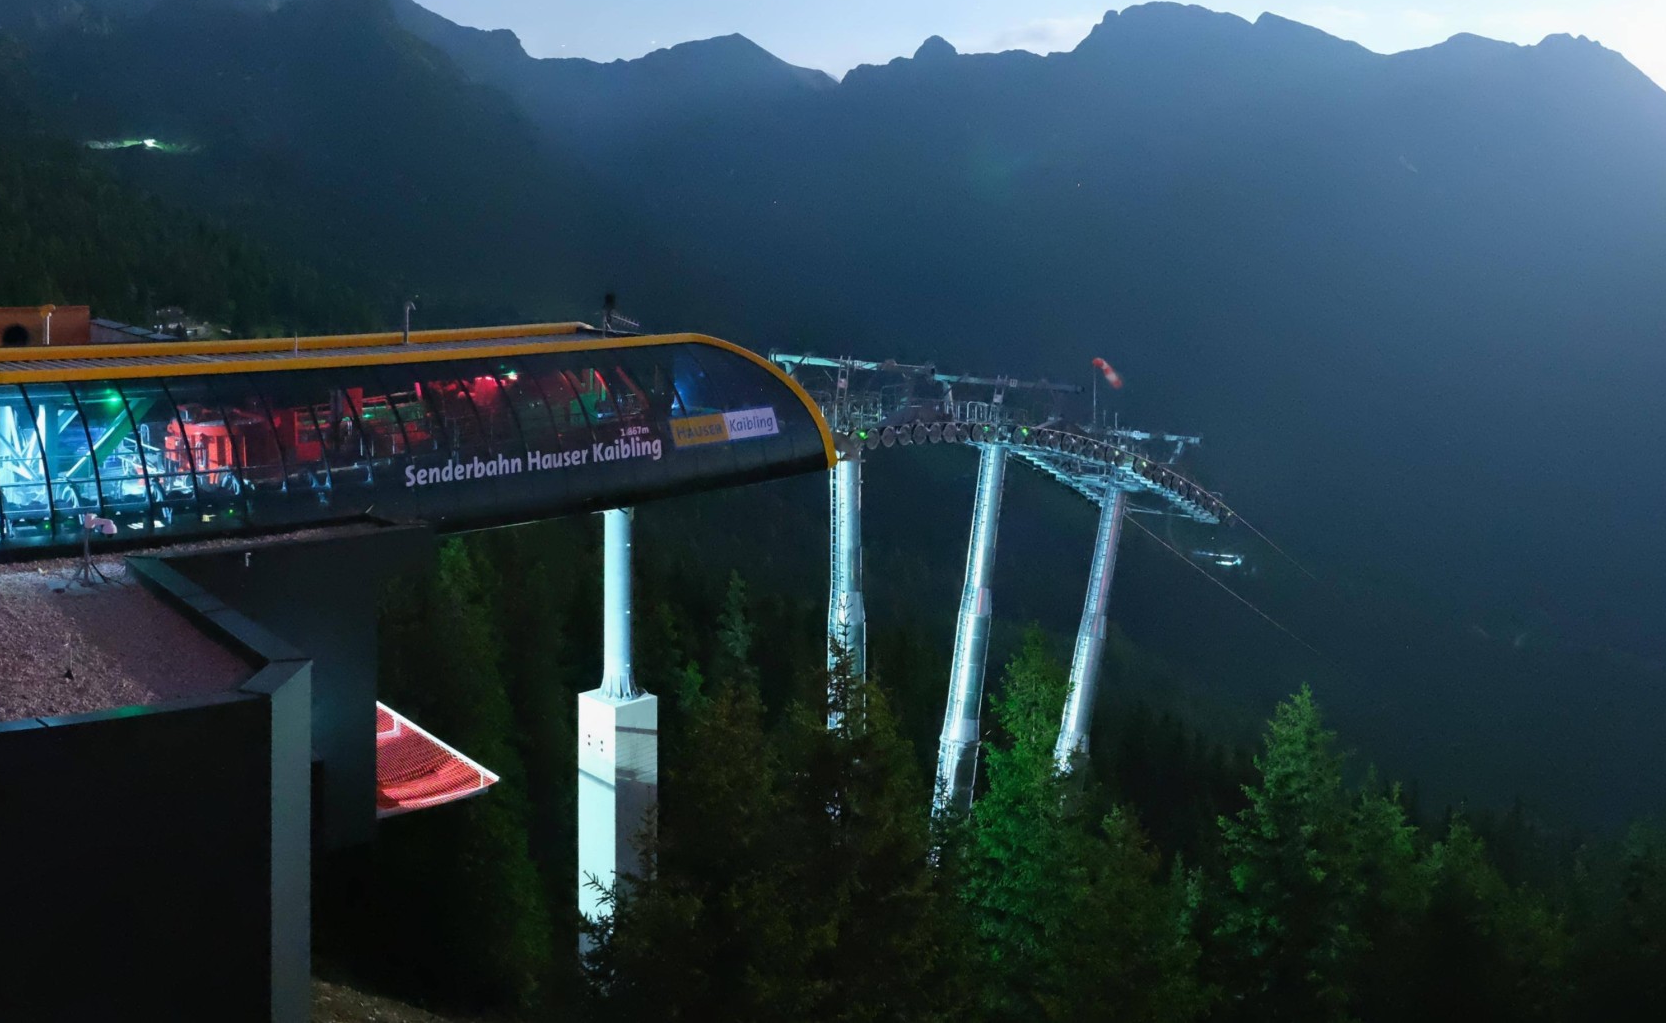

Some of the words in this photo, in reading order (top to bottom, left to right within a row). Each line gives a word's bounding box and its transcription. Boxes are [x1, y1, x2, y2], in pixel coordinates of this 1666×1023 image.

[729, 416, 774, 432] Kaibling
[404, 453, 522, 488] Senderbahn
[527, 448, 589, 472] Hauser
[592, 436, 663, 463] Kaibling
